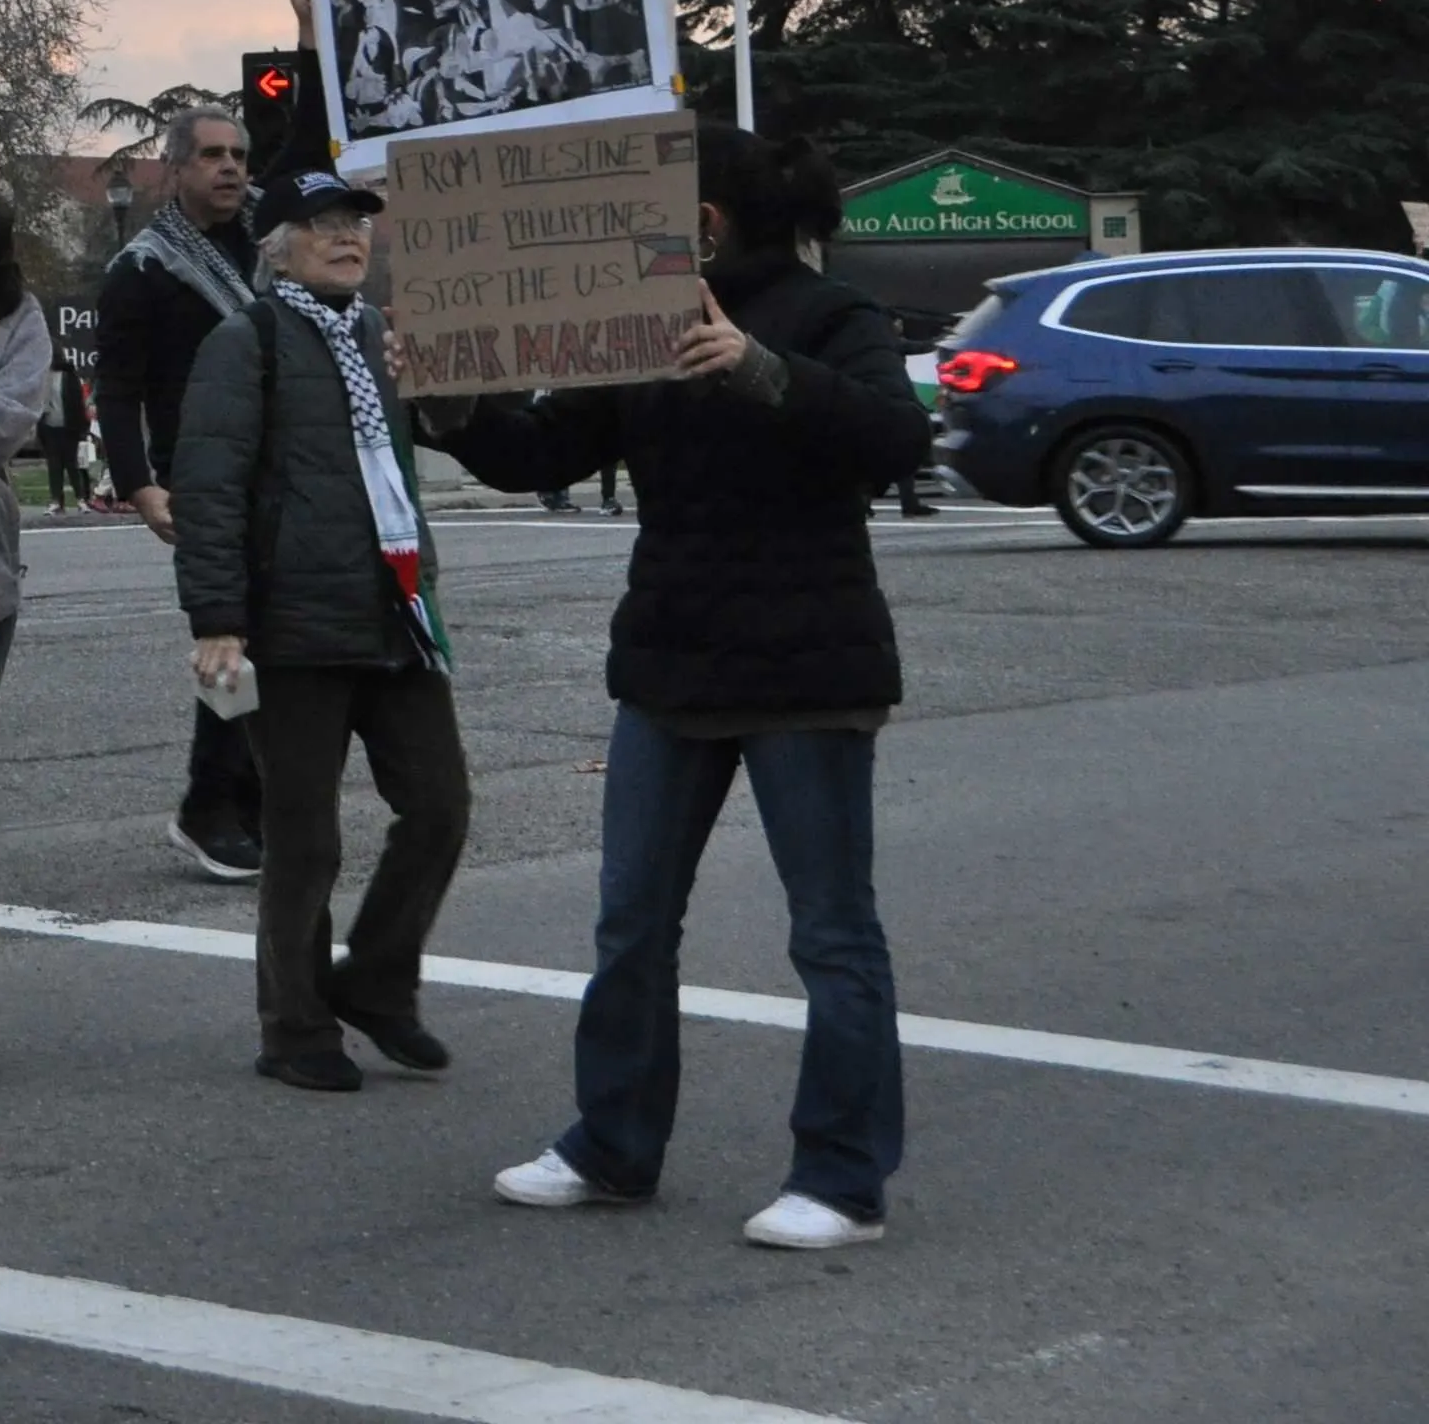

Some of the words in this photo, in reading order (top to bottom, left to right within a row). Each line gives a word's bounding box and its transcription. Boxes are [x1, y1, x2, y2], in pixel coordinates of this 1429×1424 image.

[395, 145, 482, 194] FROM
[496, 133, 649, 181] PALESTINE
[395, 216, 432, 254] TO
[439, 212, 491, 255] THE
[502, 200, 668, 246] PHILIPPINES
[842, 215, 880, 233] ALO
[886, 213, 934, 232] ALTO
[941, 212, 990, 231] HIGH
[996, 211, 1077, 231] SCHOOL
[404, 272, 493, 316] STOP
[497, 265, 560, 307] THE
[403, 326, 507, 389] WAR
